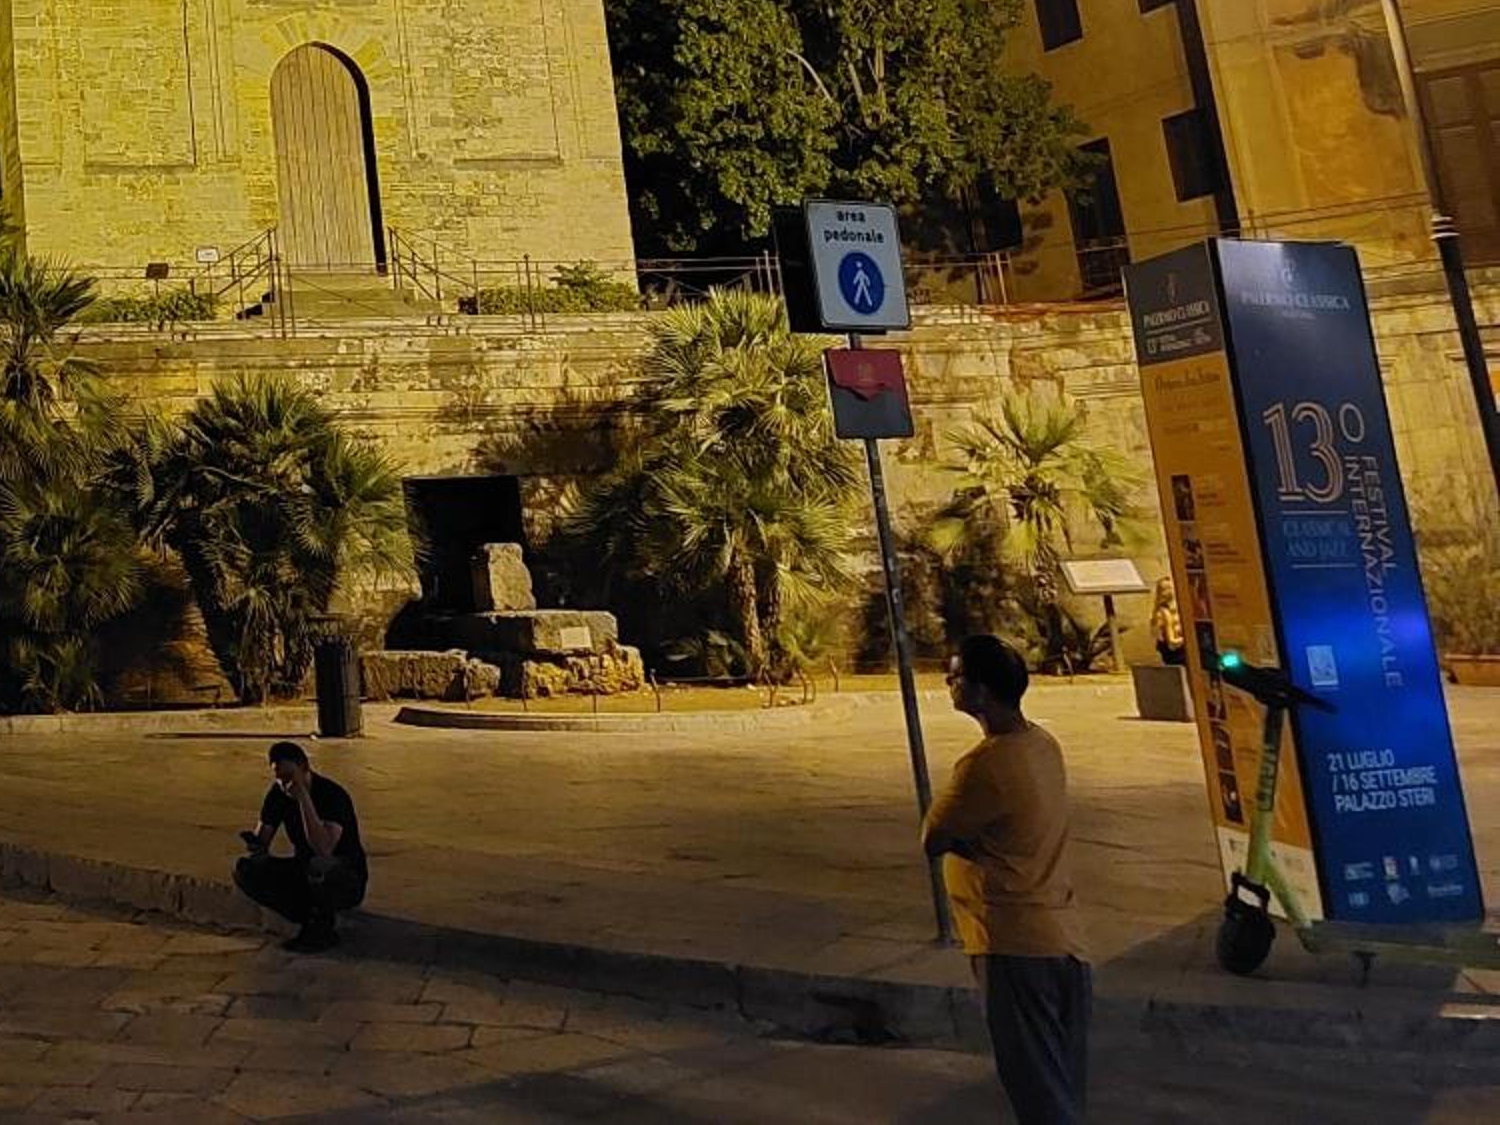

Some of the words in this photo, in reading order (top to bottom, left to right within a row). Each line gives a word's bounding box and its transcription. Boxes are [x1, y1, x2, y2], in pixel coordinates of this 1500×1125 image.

[836, 211, 866, 222] area
[823, 227, 884, 243] pedonale
[1360, 455, 1397, 573] FESTIVAL
[1344, 455, 1403, 688] INTERNAZIONALE
[1328, 754, 1344, 771] 21
[1347, 749, 1395, 769] LUGLIO
[1341, 773, 1359, 791] 16
[1360, 766, 1438, 789] SETTEMBRE
[1334, 791, 1396, 812] PALAZZO
[1398, 787, 1435, 808] STERI
